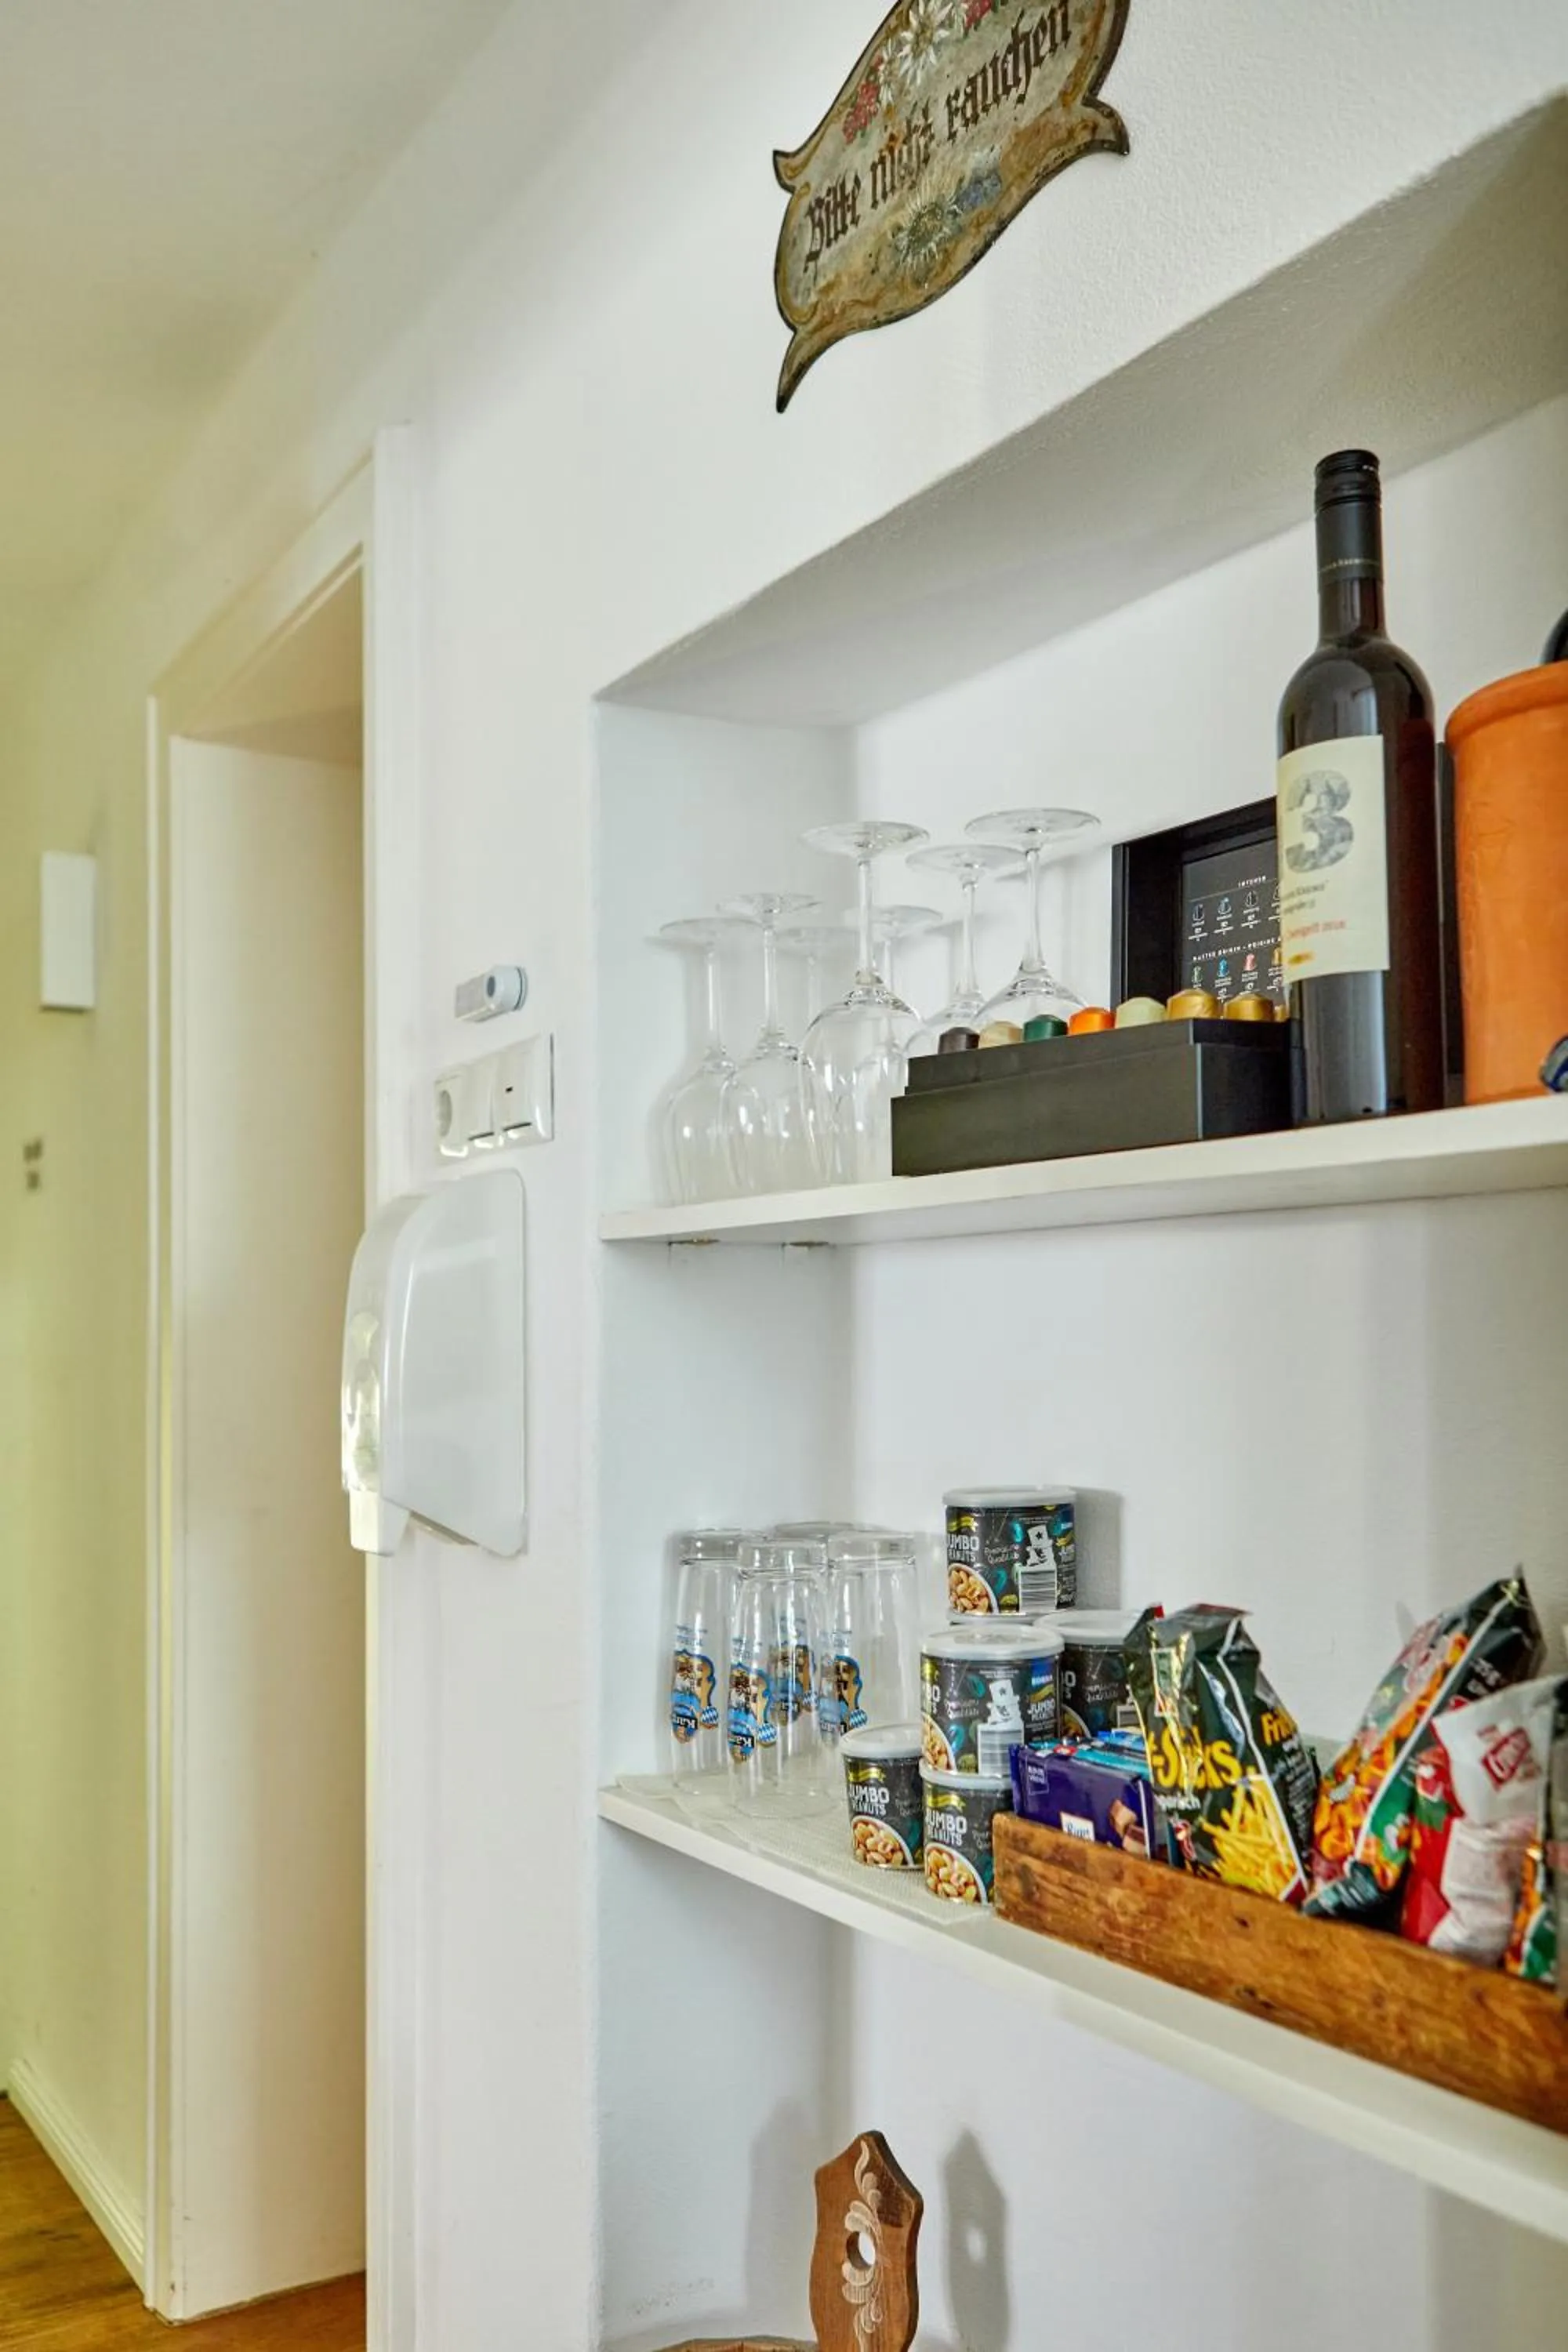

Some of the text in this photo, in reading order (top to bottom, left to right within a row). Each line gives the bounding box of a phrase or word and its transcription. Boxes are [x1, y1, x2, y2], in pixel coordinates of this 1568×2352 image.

[1286, 770, 1354, 873] 3
[849, 1785, 890, 1804] JUMBO
[852, 1802, 887, 1817] PEANUTS
[925, 1807, 967, 1835] JUMBO
[927, 1827, 964, 1847] PEANUTS
